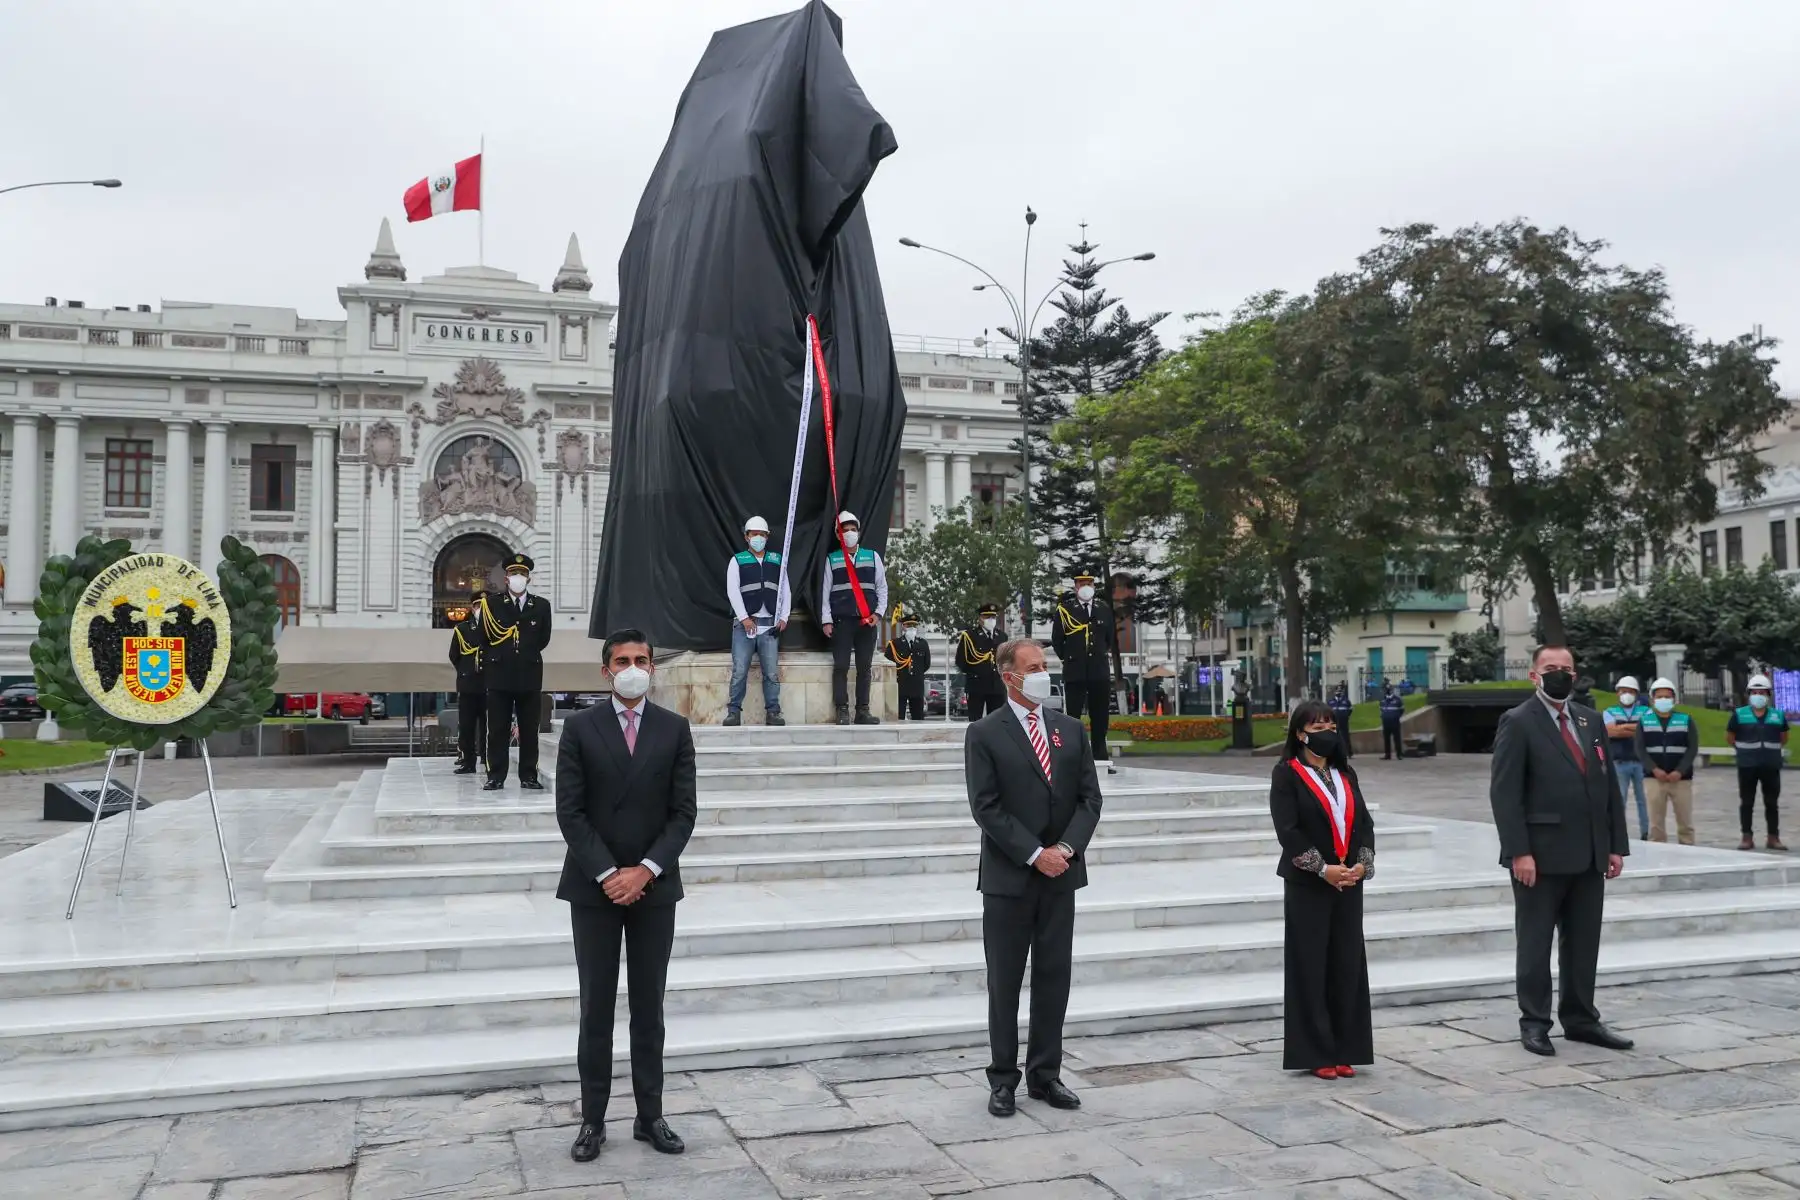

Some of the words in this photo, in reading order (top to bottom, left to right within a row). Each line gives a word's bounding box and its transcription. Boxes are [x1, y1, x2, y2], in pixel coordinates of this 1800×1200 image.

[427, 324, 533, 344] CONGRESO
[177, 563, 197, 580] DE
[196, 580, 221, 610] LIMA
[132, 639, 154, 649] HOC
[156, 639, 175, 649] SIG
[126, 651, 137, 669] EST
[161, 673, 182, 699] VERE
